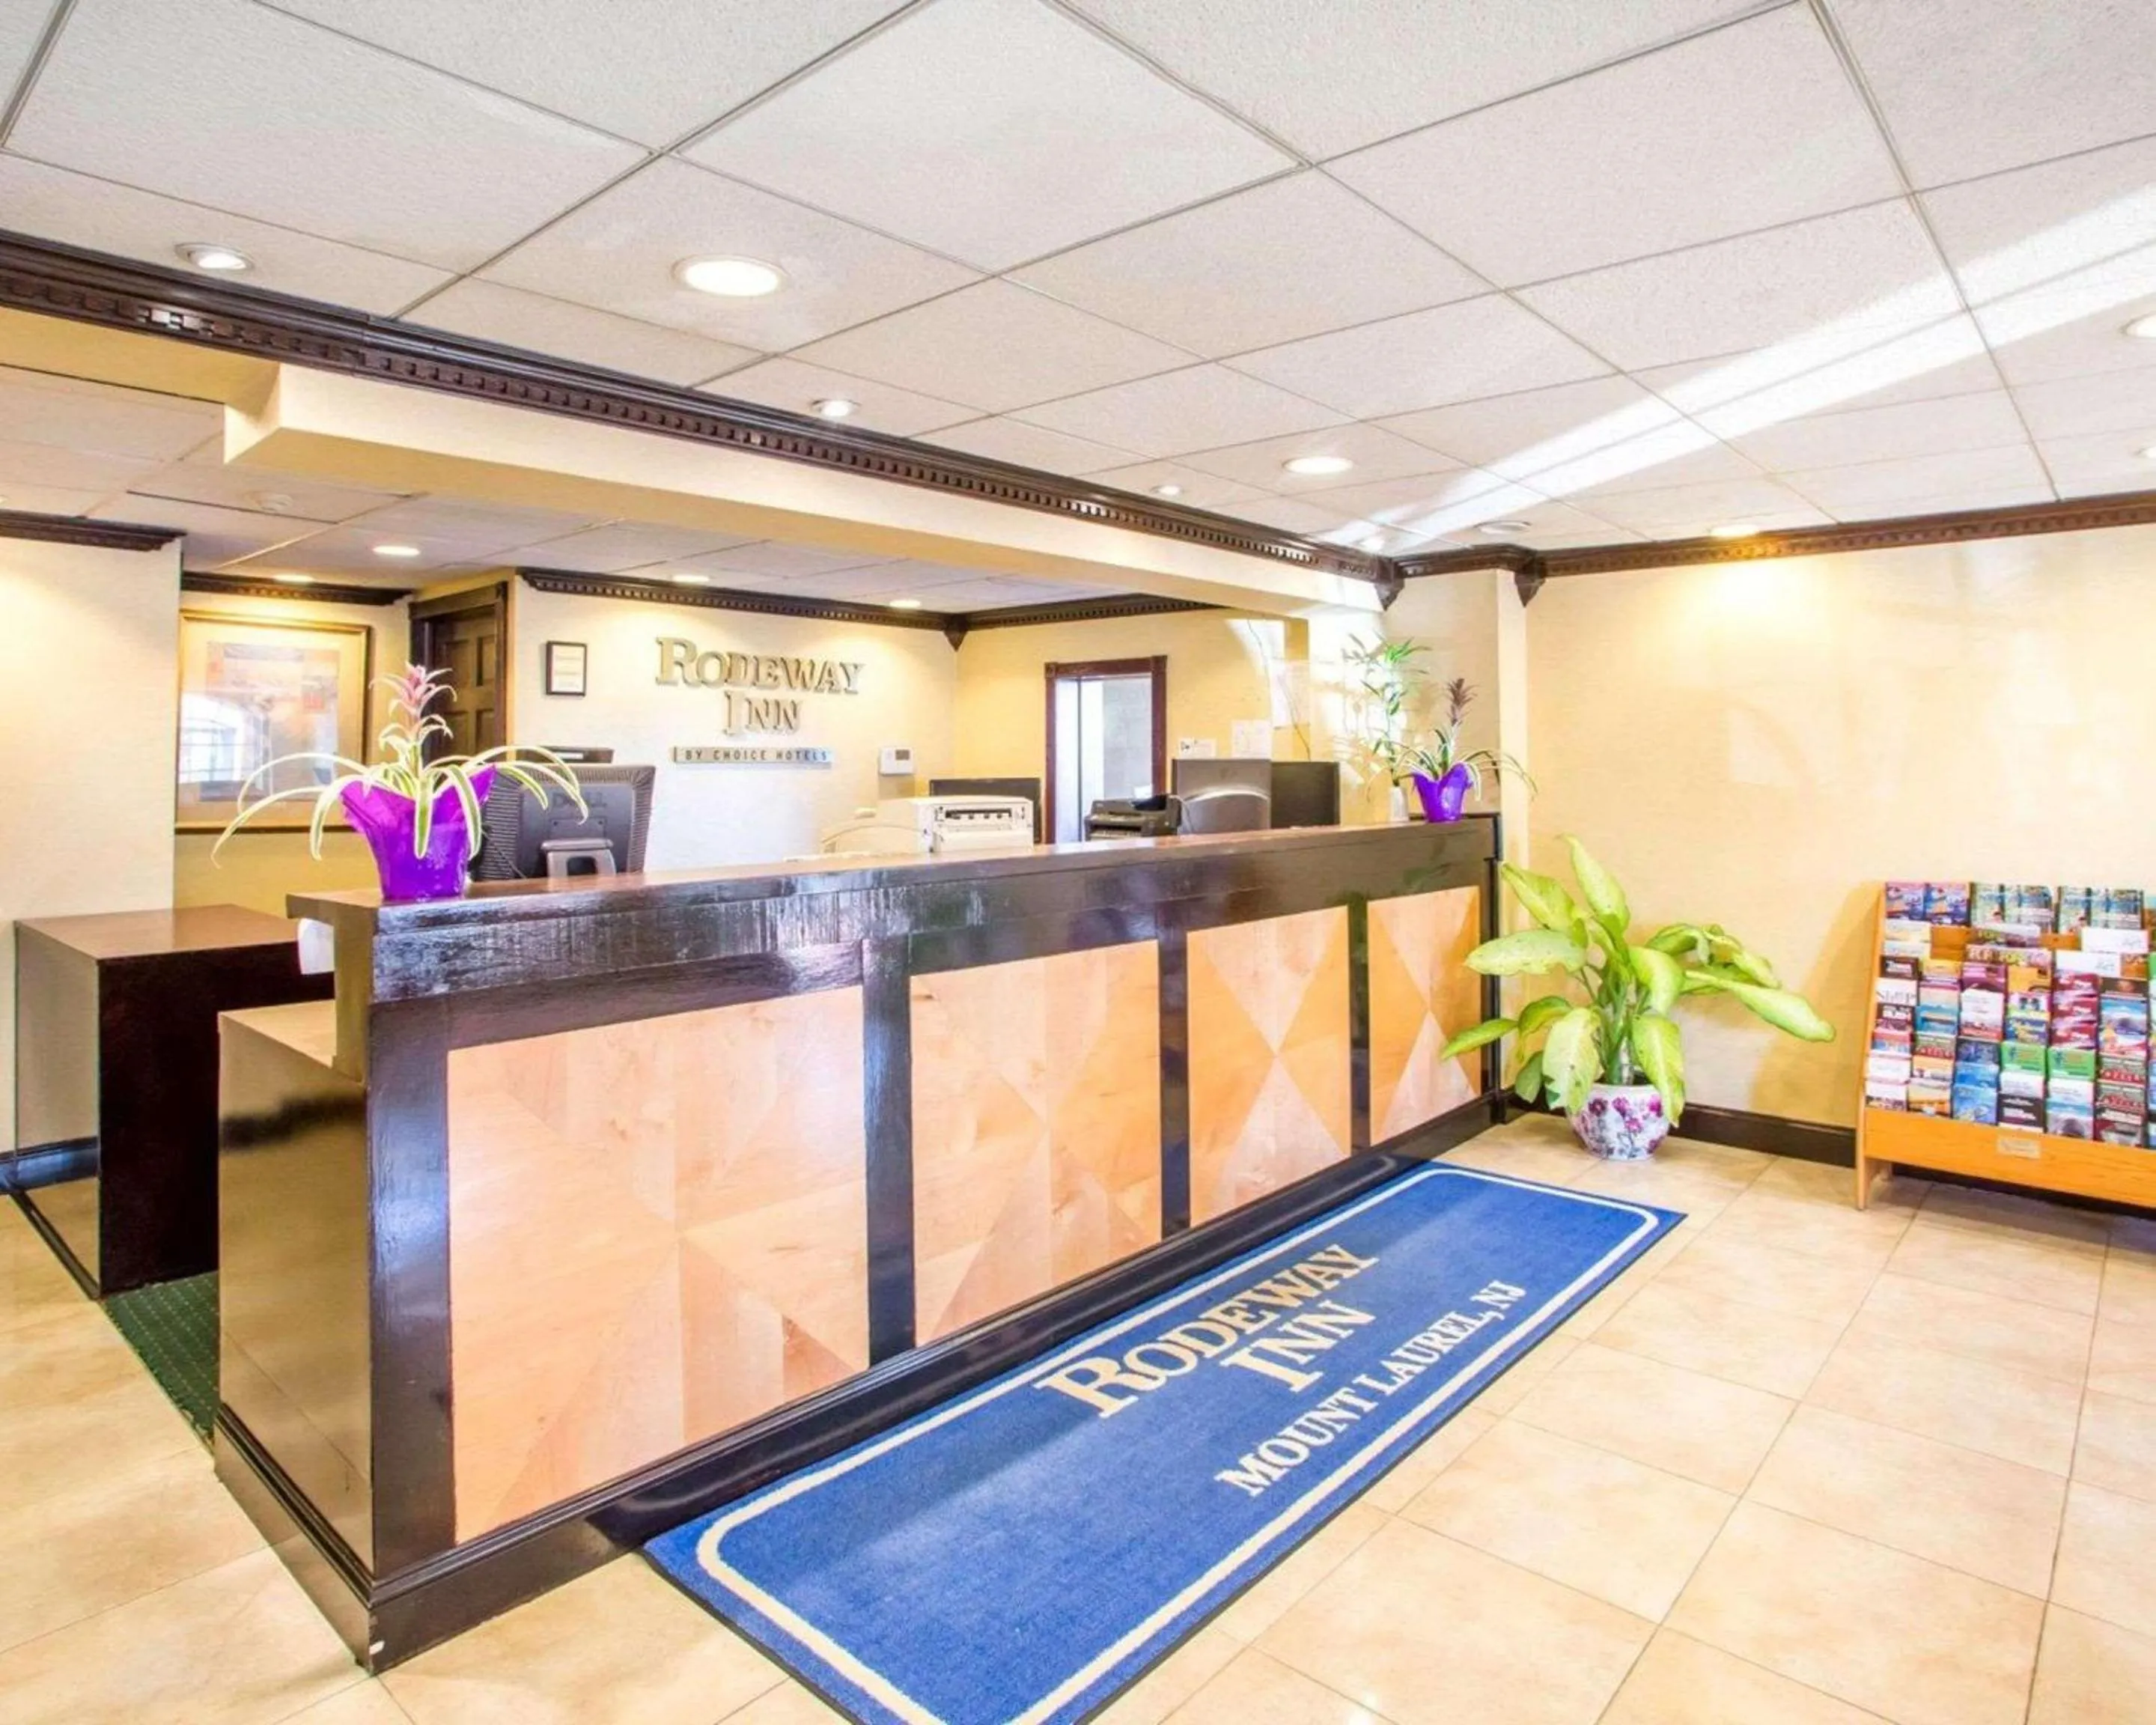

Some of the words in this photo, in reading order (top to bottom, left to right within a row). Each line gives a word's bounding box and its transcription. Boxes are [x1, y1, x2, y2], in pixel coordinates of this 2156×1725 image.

[655, 636, 865, 695] RODEWAY
[723, 690, 803, 736] INN
[686, 749, 703, 761] BY
[712, 749, 767, 761] CHOICE
[776, 749, 829, 761] HOTELS
[1033, 1244, 1380, 1419] RODEWAY
[1219, 1299, 1377, 1393] INN
[1214, 1387, 1379, 1497] MOUNT
